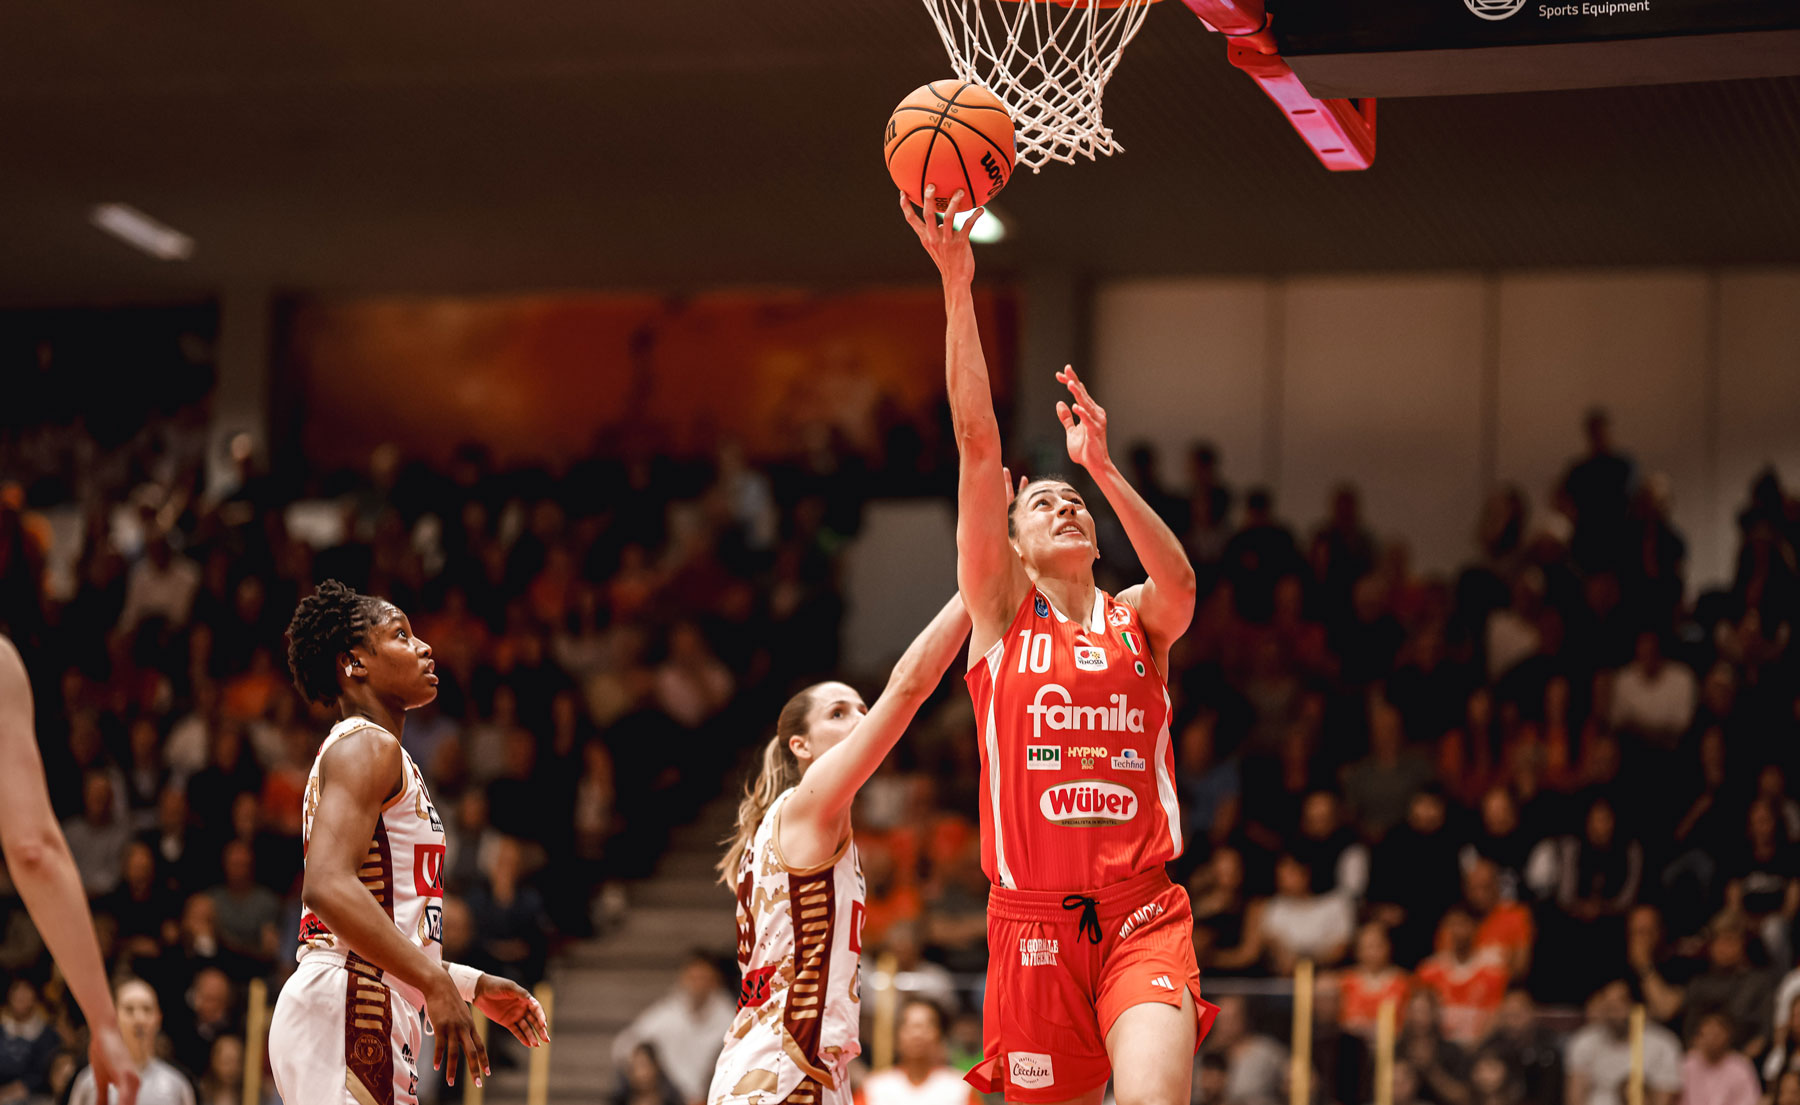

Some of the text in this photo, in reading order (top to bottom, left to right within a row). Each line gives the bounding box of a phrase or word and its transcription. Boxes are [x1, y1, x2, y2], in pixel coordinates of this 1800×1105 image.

[1539, 0, 1650, 19] Sports Equipment
[981, 151, 1004, 197] lson
[1018, 629, 1052, 674] 10
[1027, 683, 1145, 738] famila
[1028, 748, 1060, 762] HDI
[1067, 746, 1108, 758] HYPNO
[1113, 759, 1145, 770] Techfind
[1048, 786, 1134, 815] Wüber
